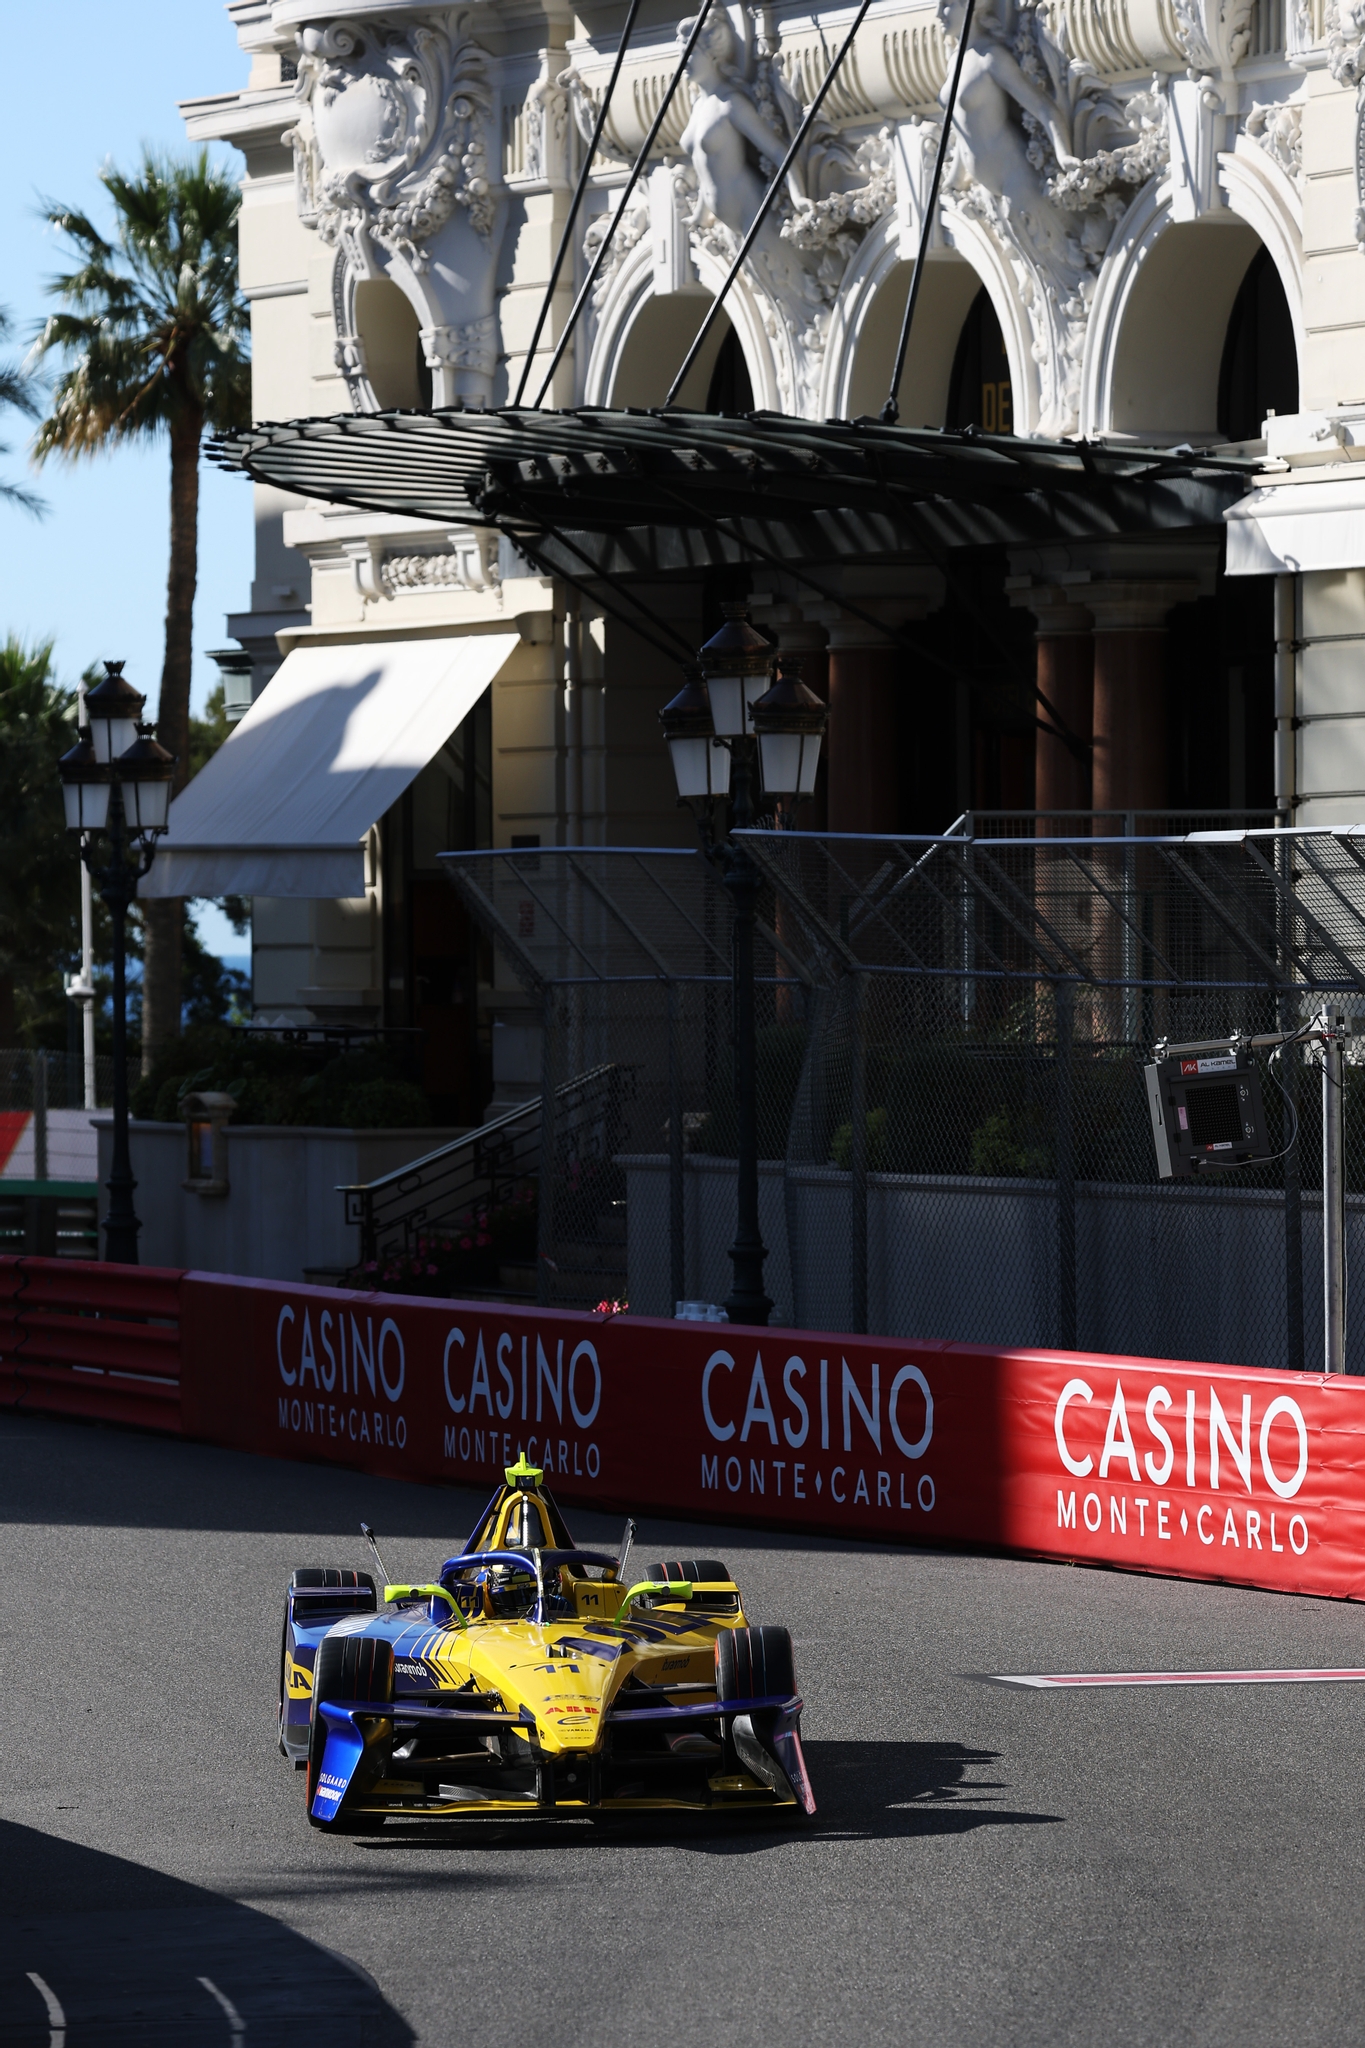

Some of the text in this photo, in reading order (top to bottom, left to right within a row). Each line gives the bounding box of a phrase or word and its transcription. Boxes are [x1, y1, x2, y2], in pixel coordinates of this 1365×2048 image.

[277, 1304, 405, 1402] CASINO
[443, 1327, 602, 1429] CASINO
[278, 1398, 406, 1449] MONTE CARLO
[701, 1349, 934, 1459] CASINO
[444, 1425, 600, 1478] MONTE CARLO
[1053, 1377, 1308, 1499] CASINO
[701, 1454, 936, 1512] MONTE CARLO
[1057, 1489, 1309, 1555] MONTE CARLO
[581, 1594, 599, 1606] 11
[533, 1664, 580, 1674] 11
